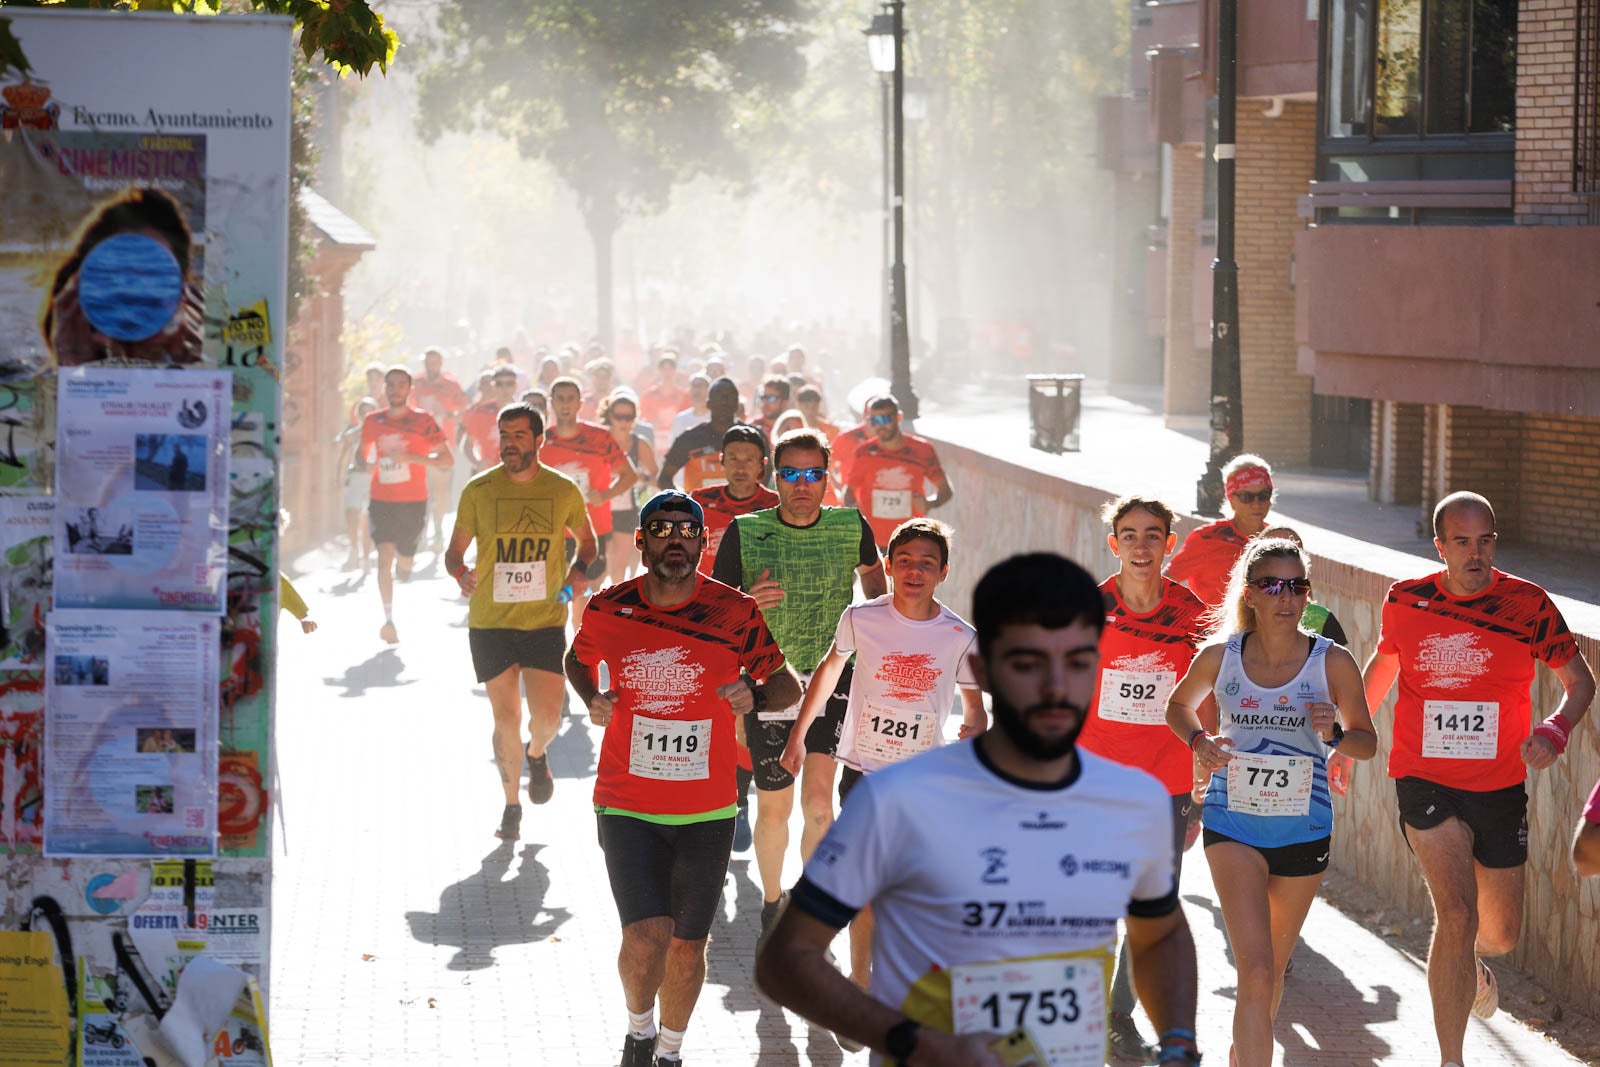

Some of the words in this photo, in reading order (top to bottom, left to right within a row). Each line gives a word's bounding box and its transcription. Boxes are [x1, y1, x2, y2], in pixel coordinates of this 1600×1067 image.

[73, 106, 138, 126] Excmo.
[144, 108, 273, 129] Ayuntamiento
[505, 571, 532, 584] 760
[1419, 649, 1485, 664] carrera
[623, 665, 696, 680] carrera
[882, 663, 937, 681] carrera
[625, 680, 696, 692] cruzroja.es
[1120, 682, 1156, 700] 592
[870, 715, 920, 741] 1281
[1230, 713, 1306, 728] MARACENA
[1433, 712, 1485, 732] 1412
[643, 732, 699, 753] 1119
[668, 755, 691, 763] MANUEL
[1246, 766, 1290, 788] 773
[133, 914, 180, 930] OFERTA
[962, 902, 1007, 928] 37
[981, 986, 1081, 1029] 1753
